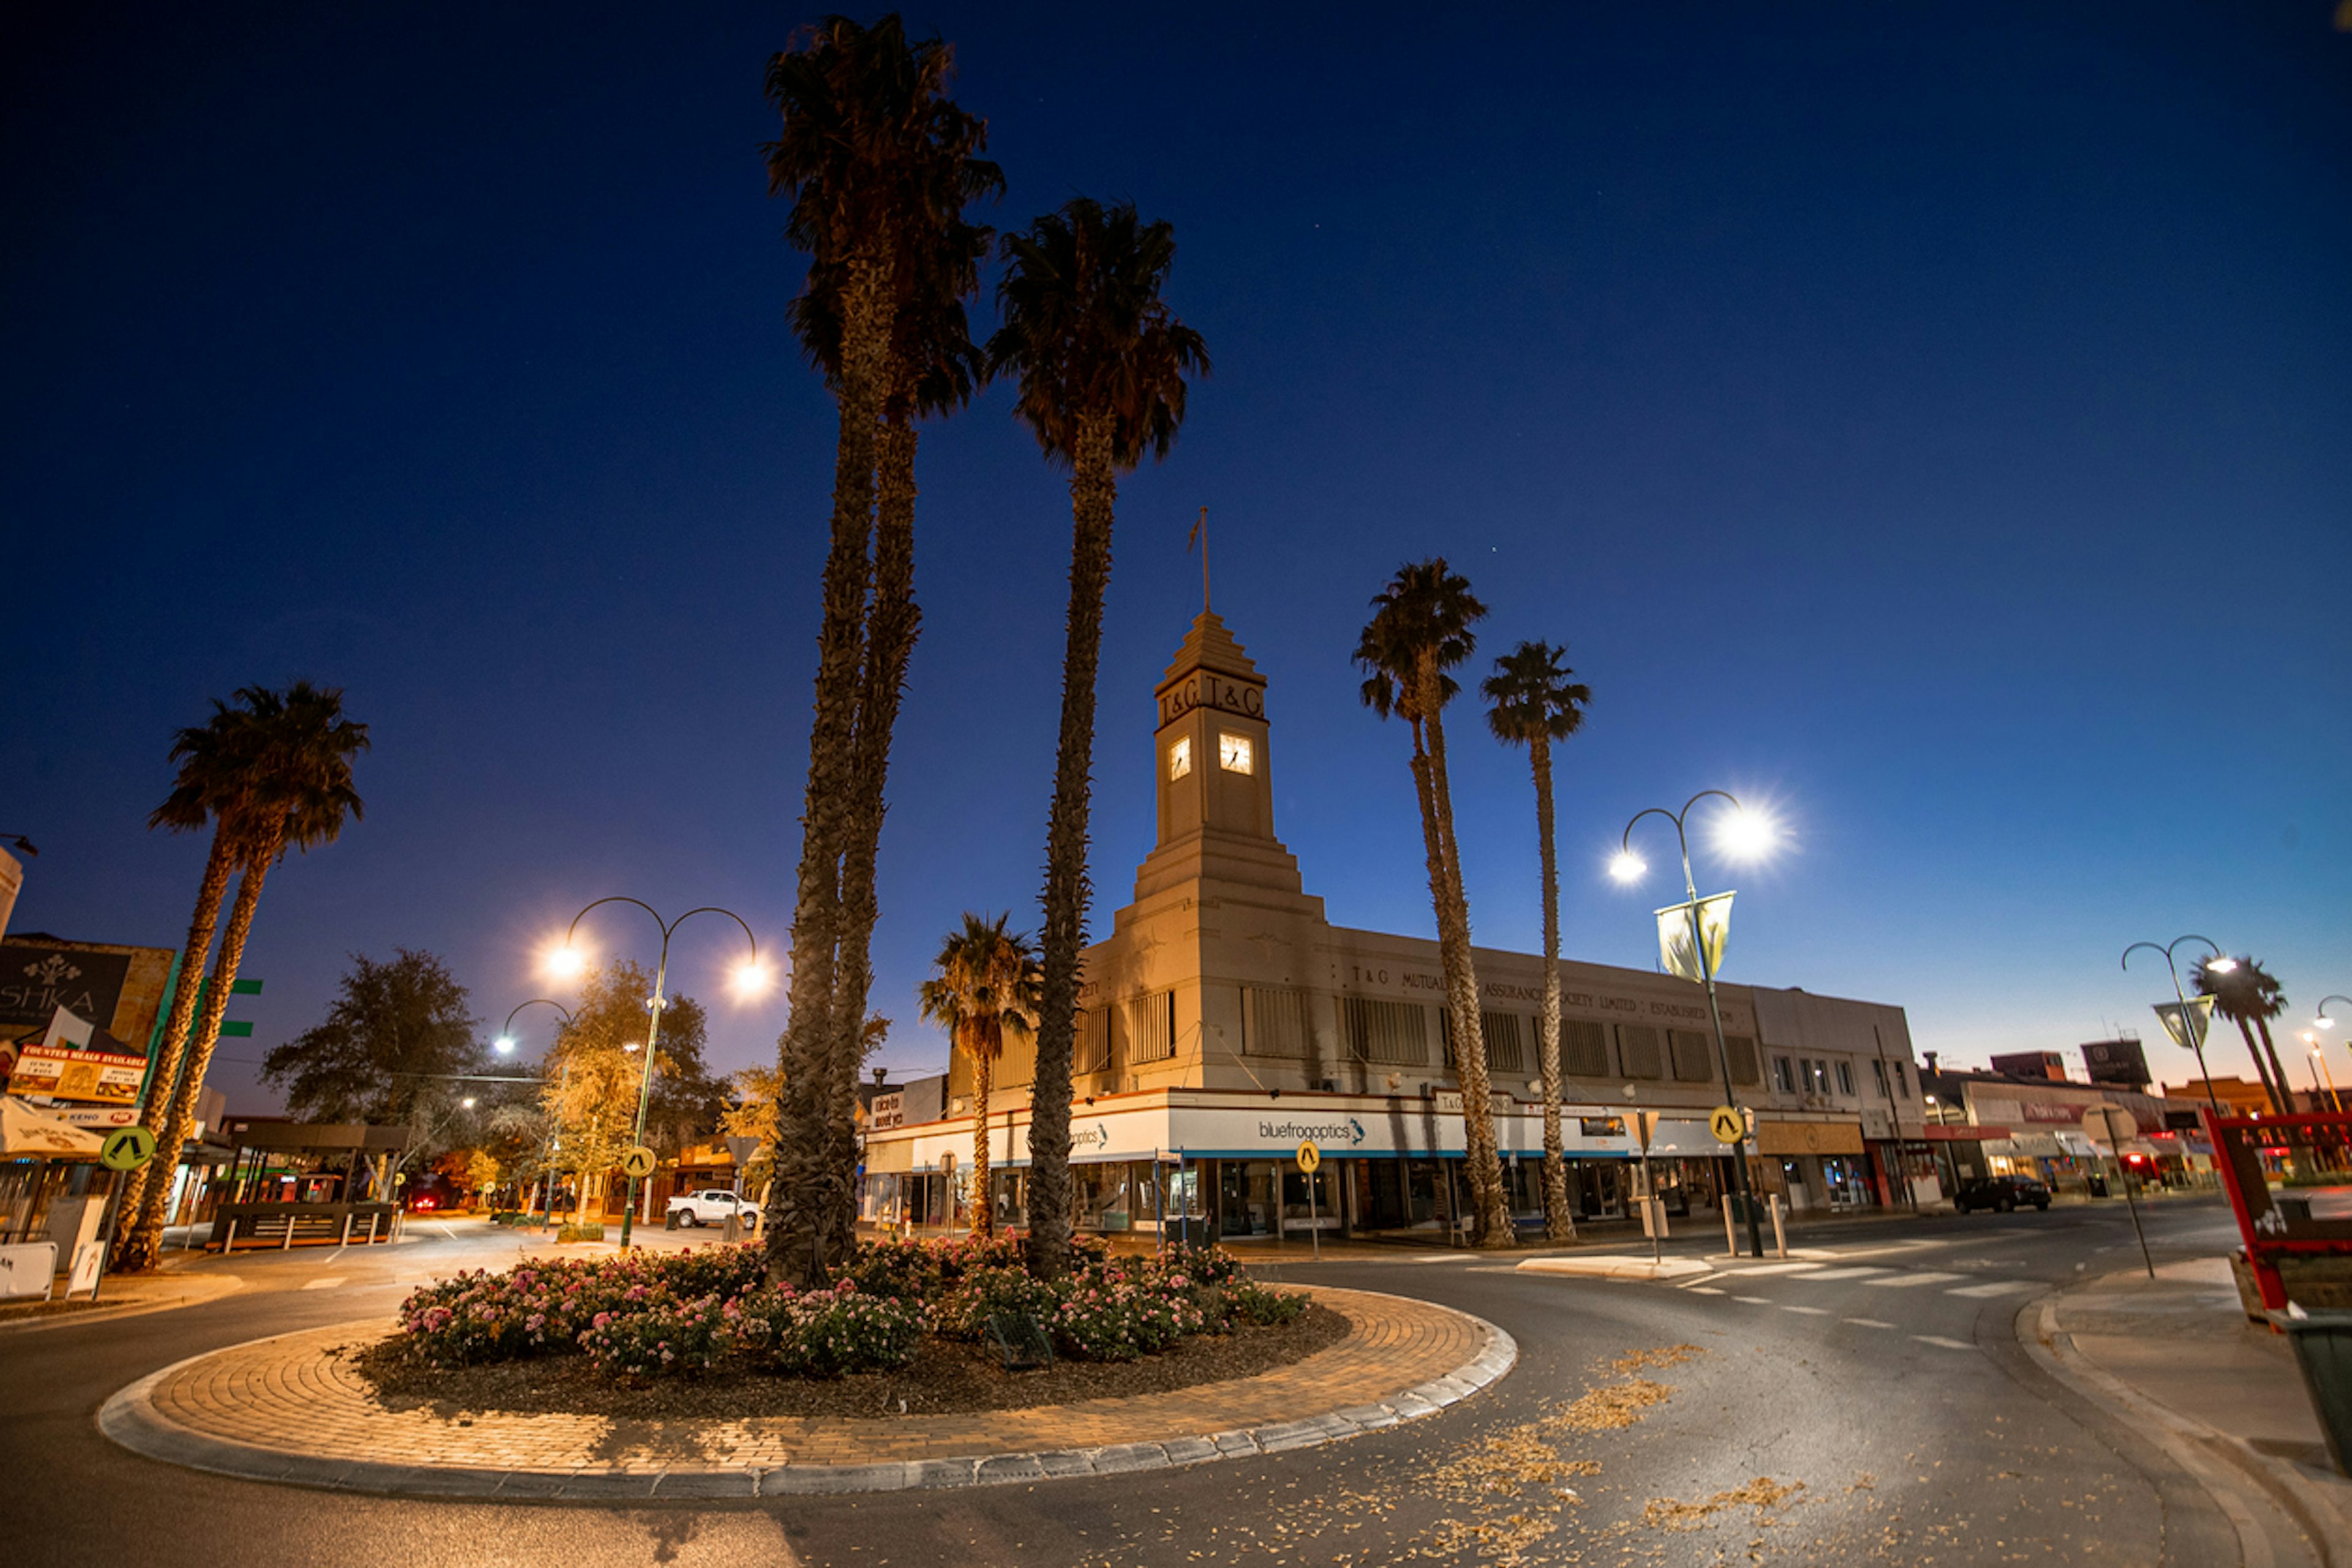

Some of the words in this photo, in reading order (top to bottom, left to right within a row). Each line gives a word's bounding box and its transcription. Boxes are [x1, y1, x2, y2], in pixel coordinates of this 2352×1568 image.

[1559, 992, 1593, 1008] OCIETY
[1599, 995, 1637, 1012] LIMITED
[23, 1045, 69, 1058] COUNTER
[70, 1051, 101, 1061] MEALS
[102, 1054, 147, 1067] AVAILABLE
[1259, 1121, 1350, 1142] bluefrogoptics
